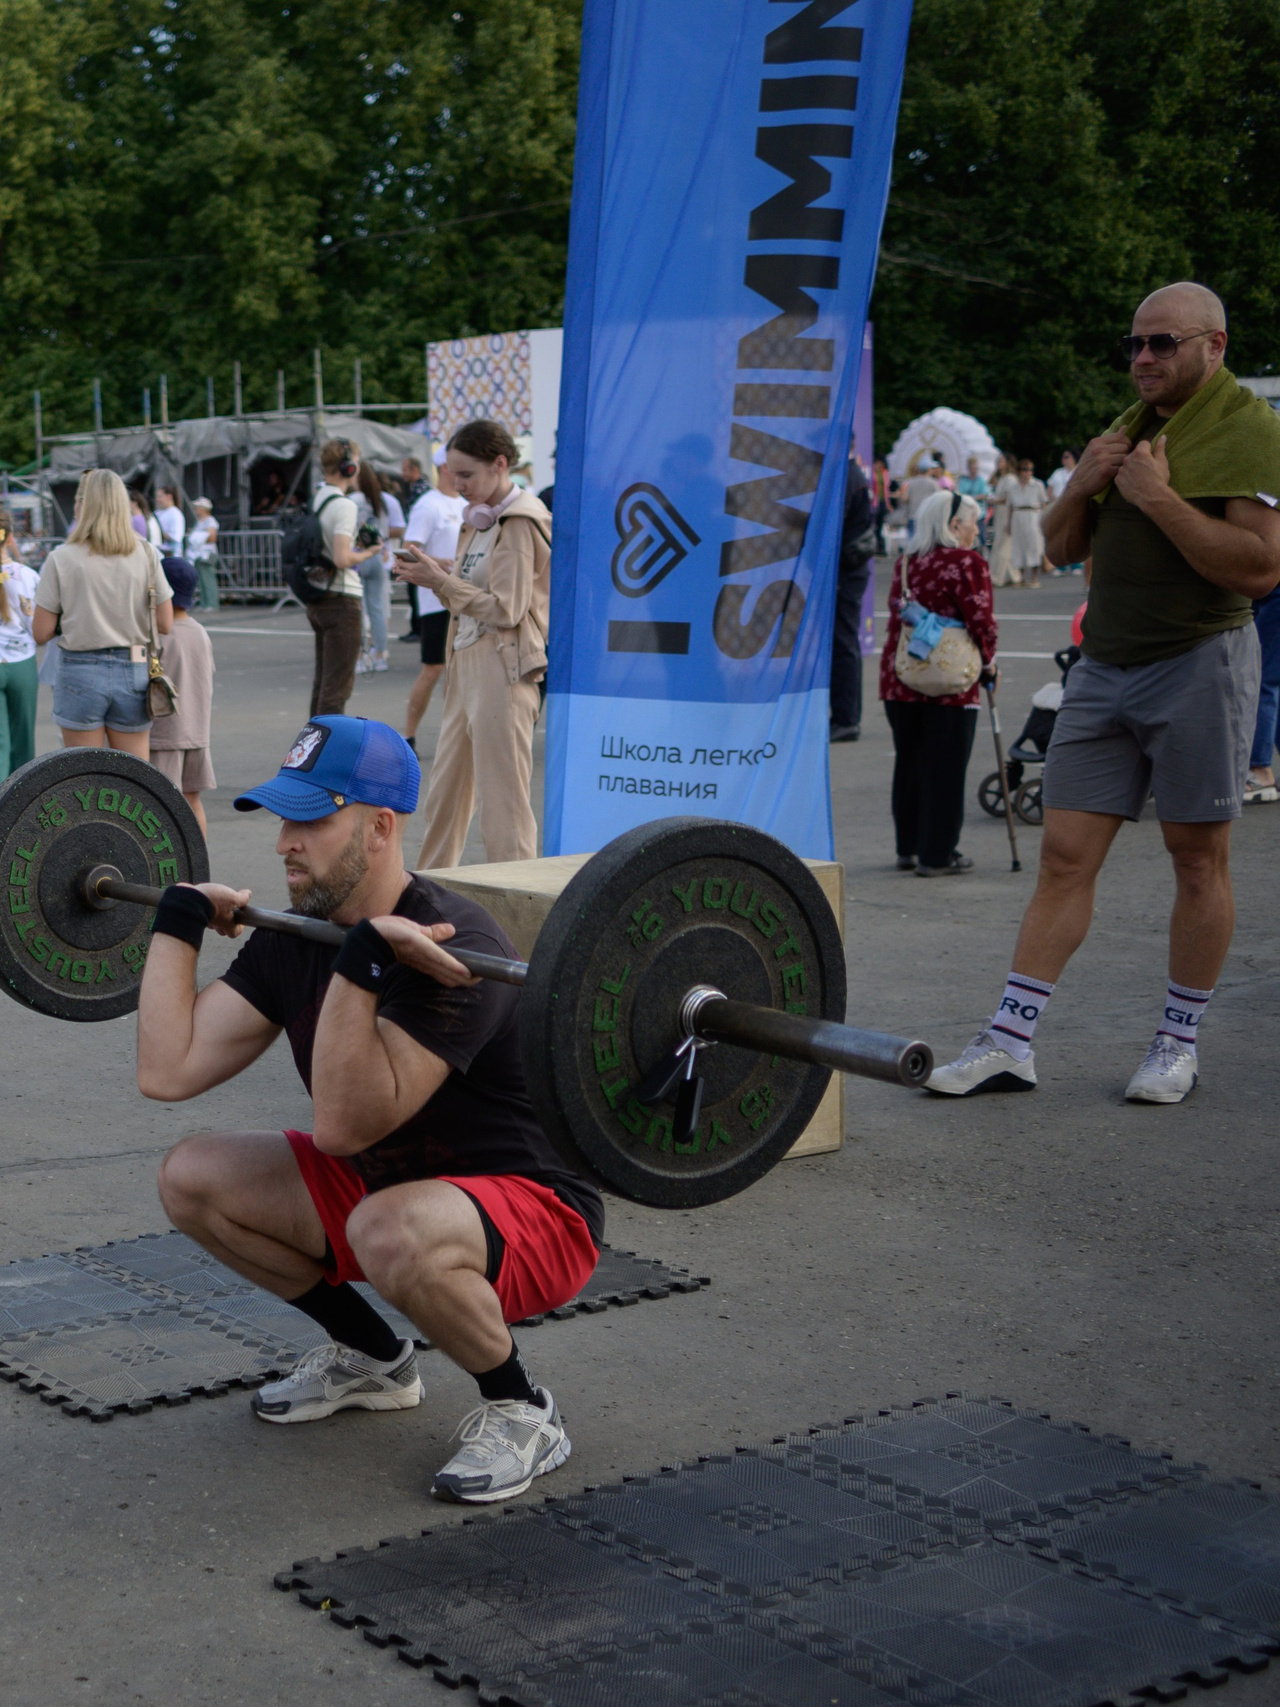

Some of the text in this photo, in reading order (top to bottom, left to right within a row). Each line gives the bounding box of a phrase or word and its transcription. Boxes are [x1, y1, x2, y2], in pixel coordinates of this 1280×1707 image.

[601, 735, 683, 764] Школа
[598, 775, 718, 800] плавания
[42, 797, 67, 827] 10
[74, 787, 179, 931] YOUSTE
[9, 840, 116, 984] YOUSTEEL
[632, 899, 664, 941] 10
